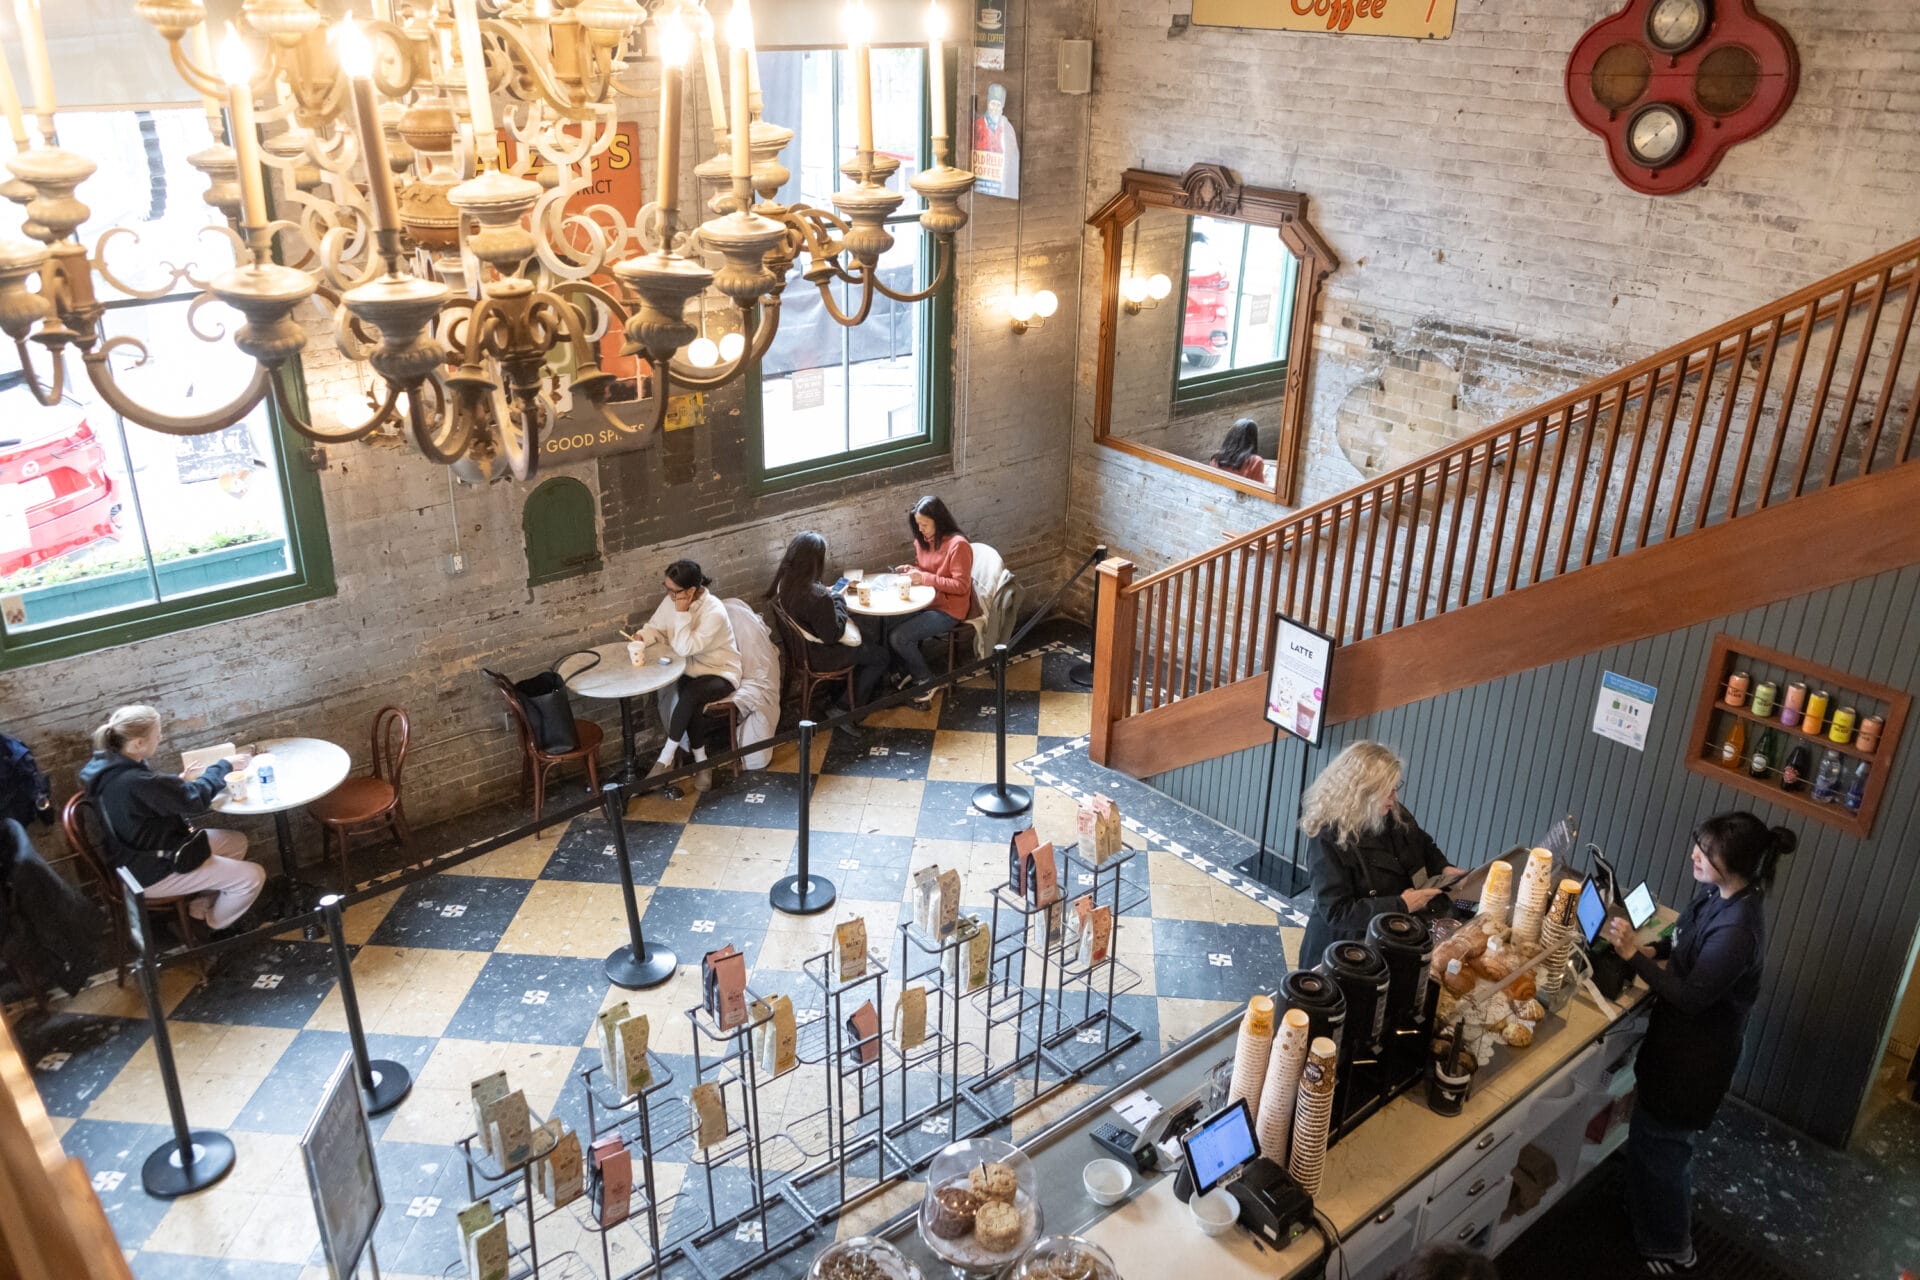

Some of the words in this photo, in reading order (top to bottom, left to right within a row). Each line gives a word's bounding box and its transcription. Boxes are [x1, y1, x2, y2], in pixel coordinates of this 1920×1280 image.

[1291, 0, 1387, 31] Coffee
[546, 433, 595, 453] GOOD
[1290, 641, 1314, 660] LATTE
